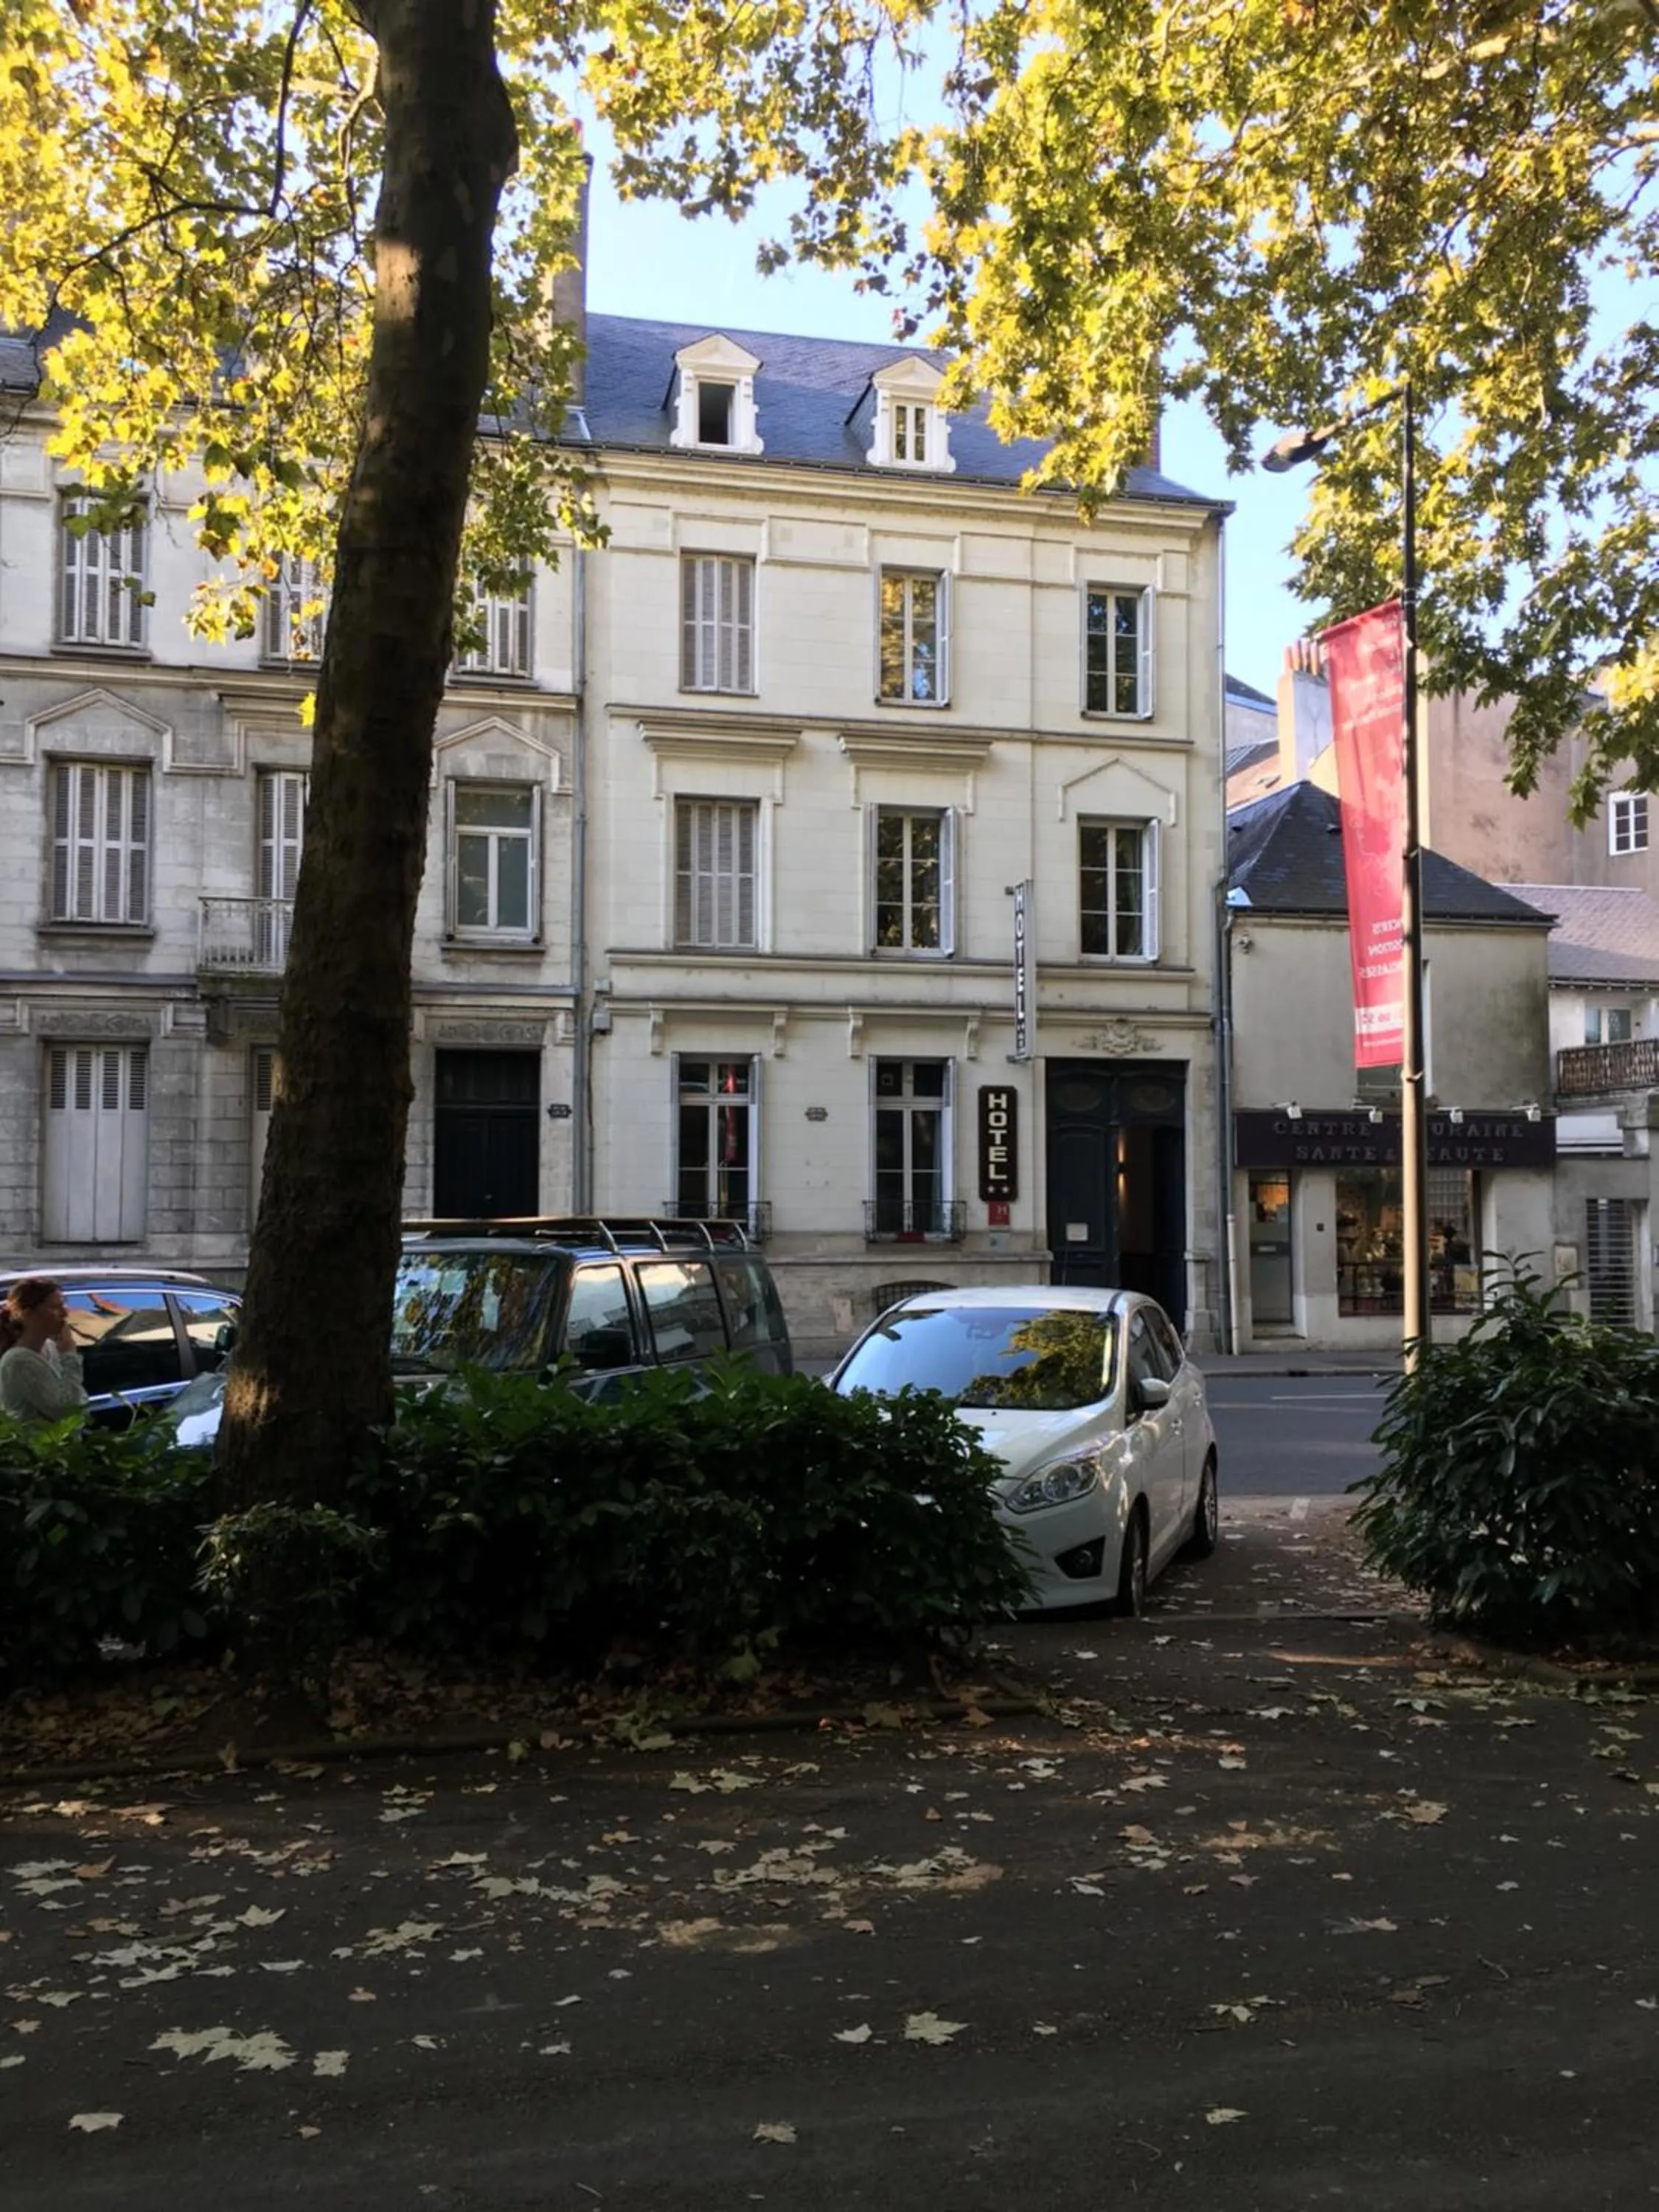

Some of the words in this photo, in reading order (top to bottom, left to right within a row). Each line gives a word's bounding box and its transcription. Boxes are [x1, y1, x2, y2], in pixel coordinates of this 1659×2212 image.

[1016, 885, 1026, 1019] HOTEL
[988, 1093, 1008, 1180] HOTEL
[1273, 1121, 1372, 1137] CENTRE
[1295, 1145, 1377, 1162] SANTE
[1425, 1146, 1506, 1162] EAUTE
